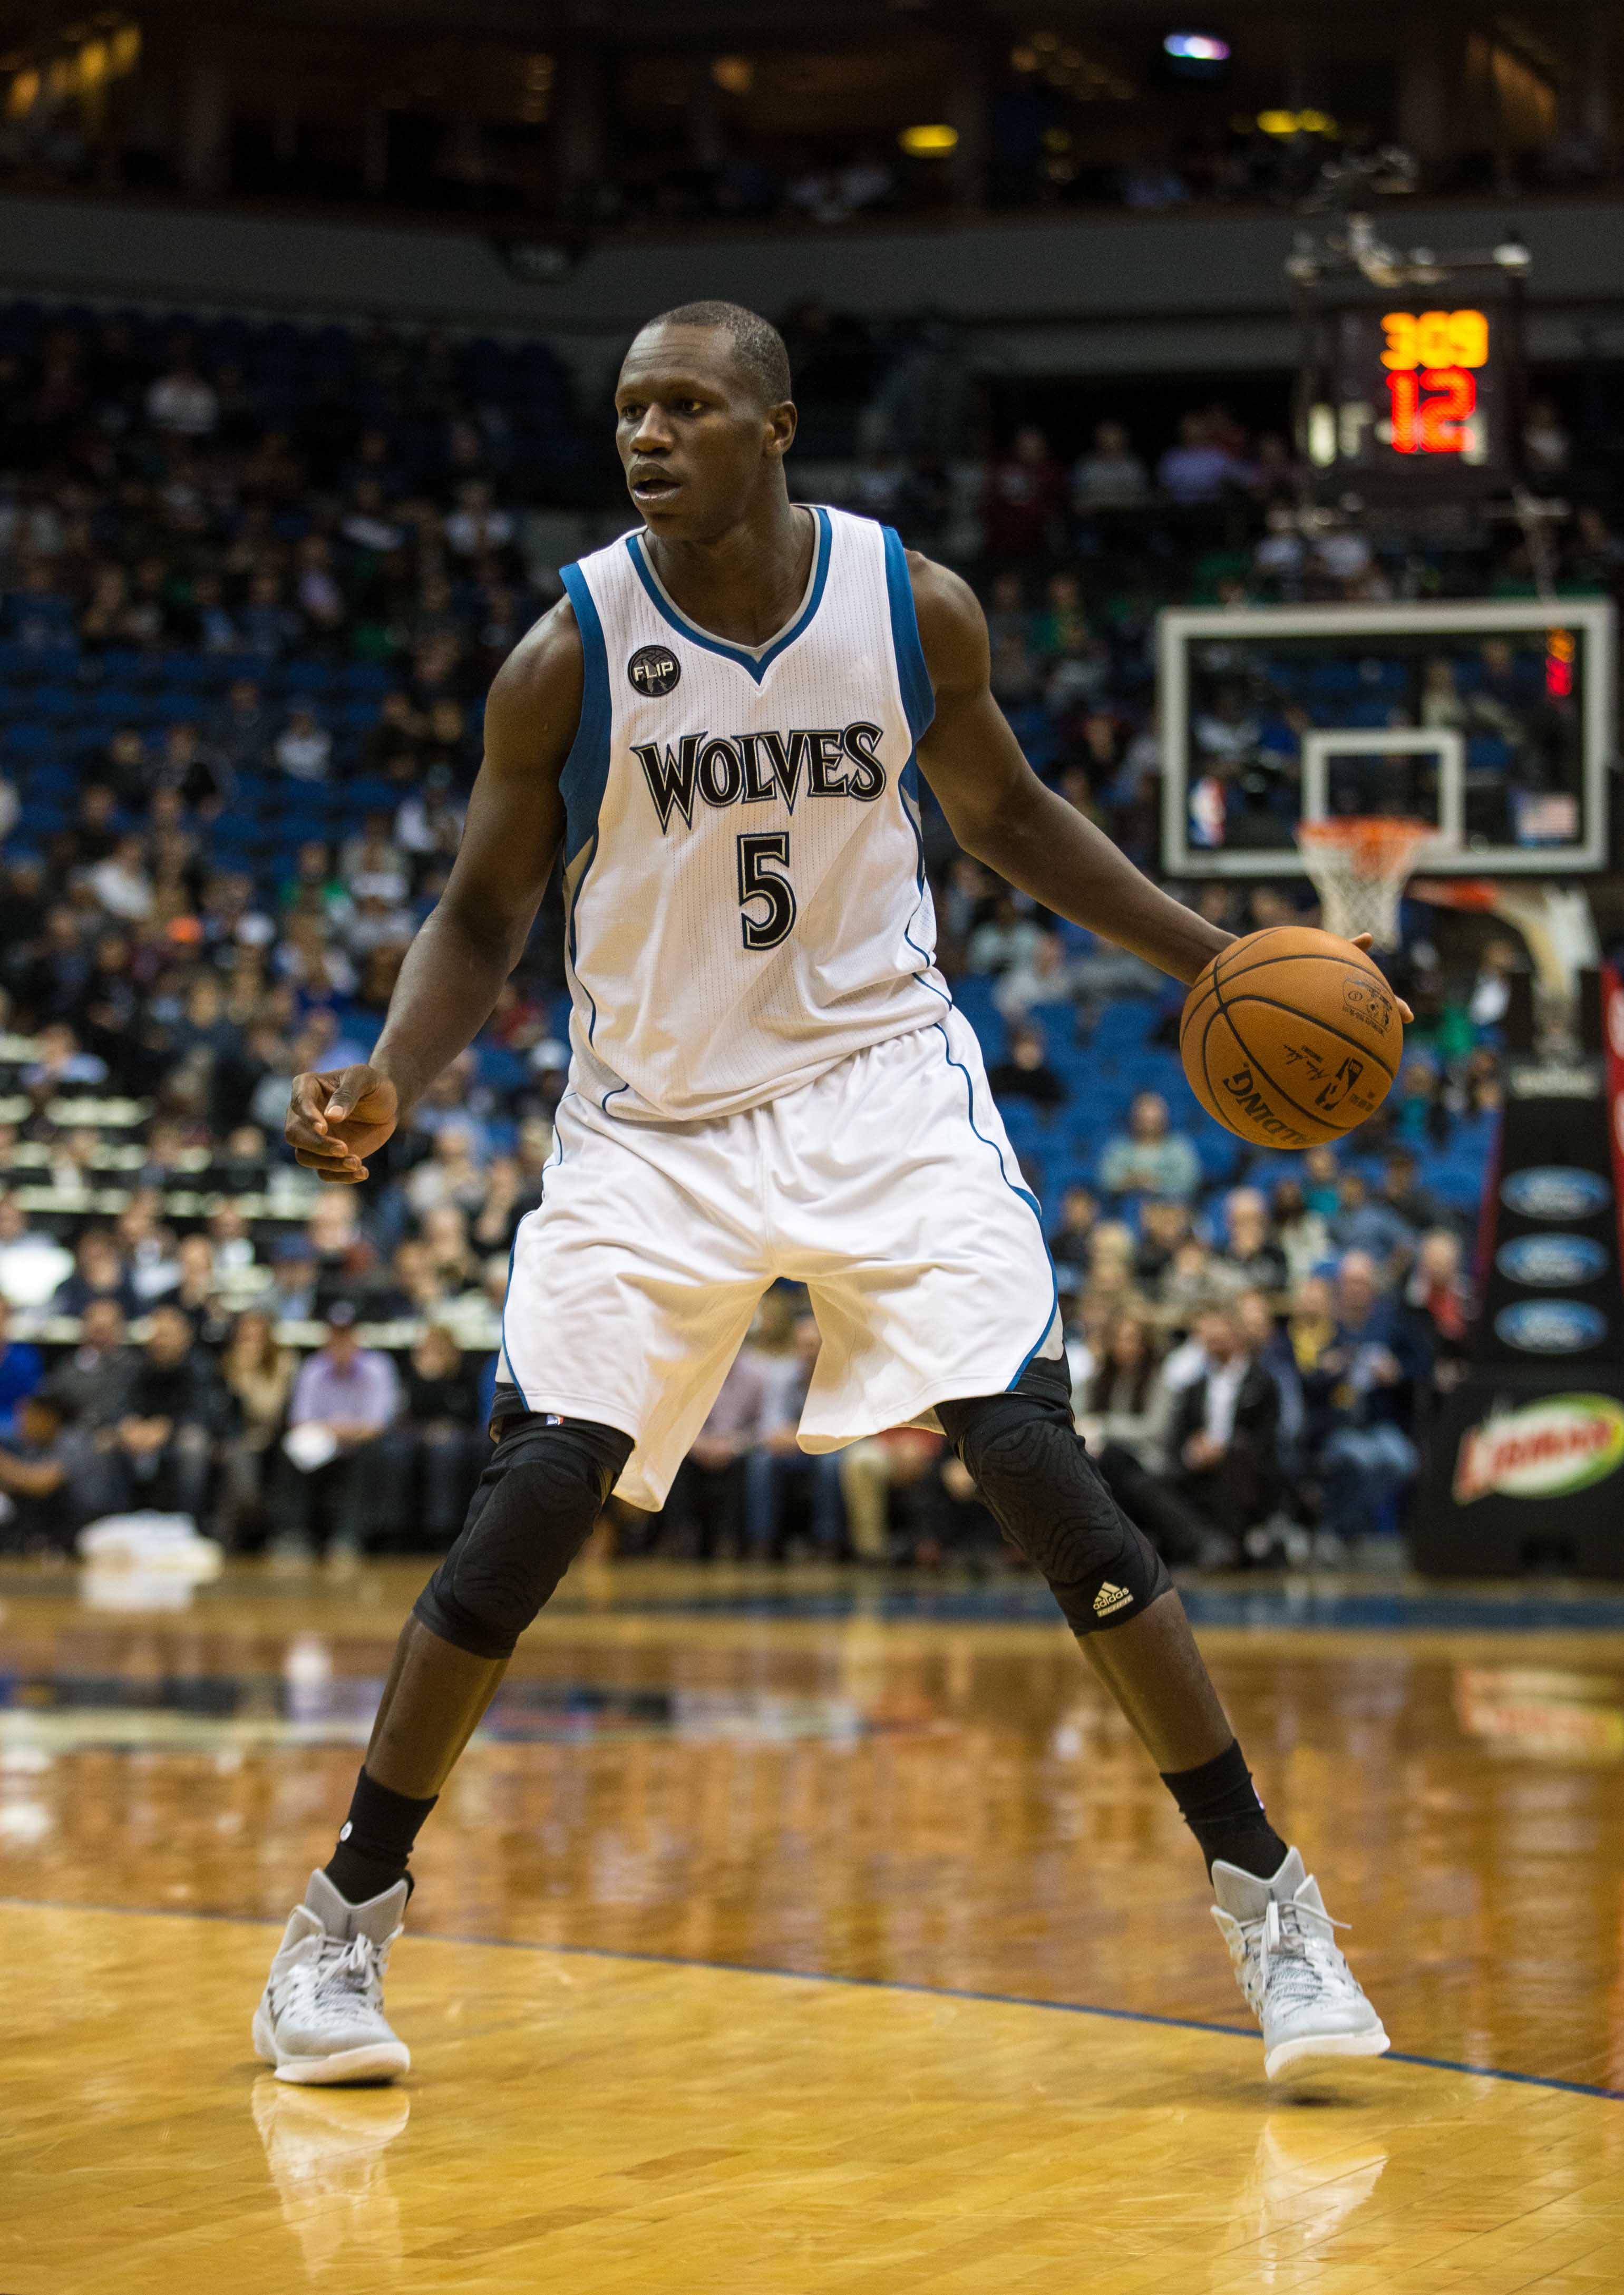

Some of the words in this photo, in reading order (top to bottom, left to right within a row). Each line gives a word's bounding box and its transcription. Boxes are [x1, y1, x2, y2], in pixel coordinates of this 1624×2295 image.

[1386, 366, 1475, 452] 12
[634, 662, 673, 682] FLIP
[629, 721, 887, 835] WOLVES
[737, 831, 796, 950] 5
[1093, 1587, 1129, 1610] adidas
